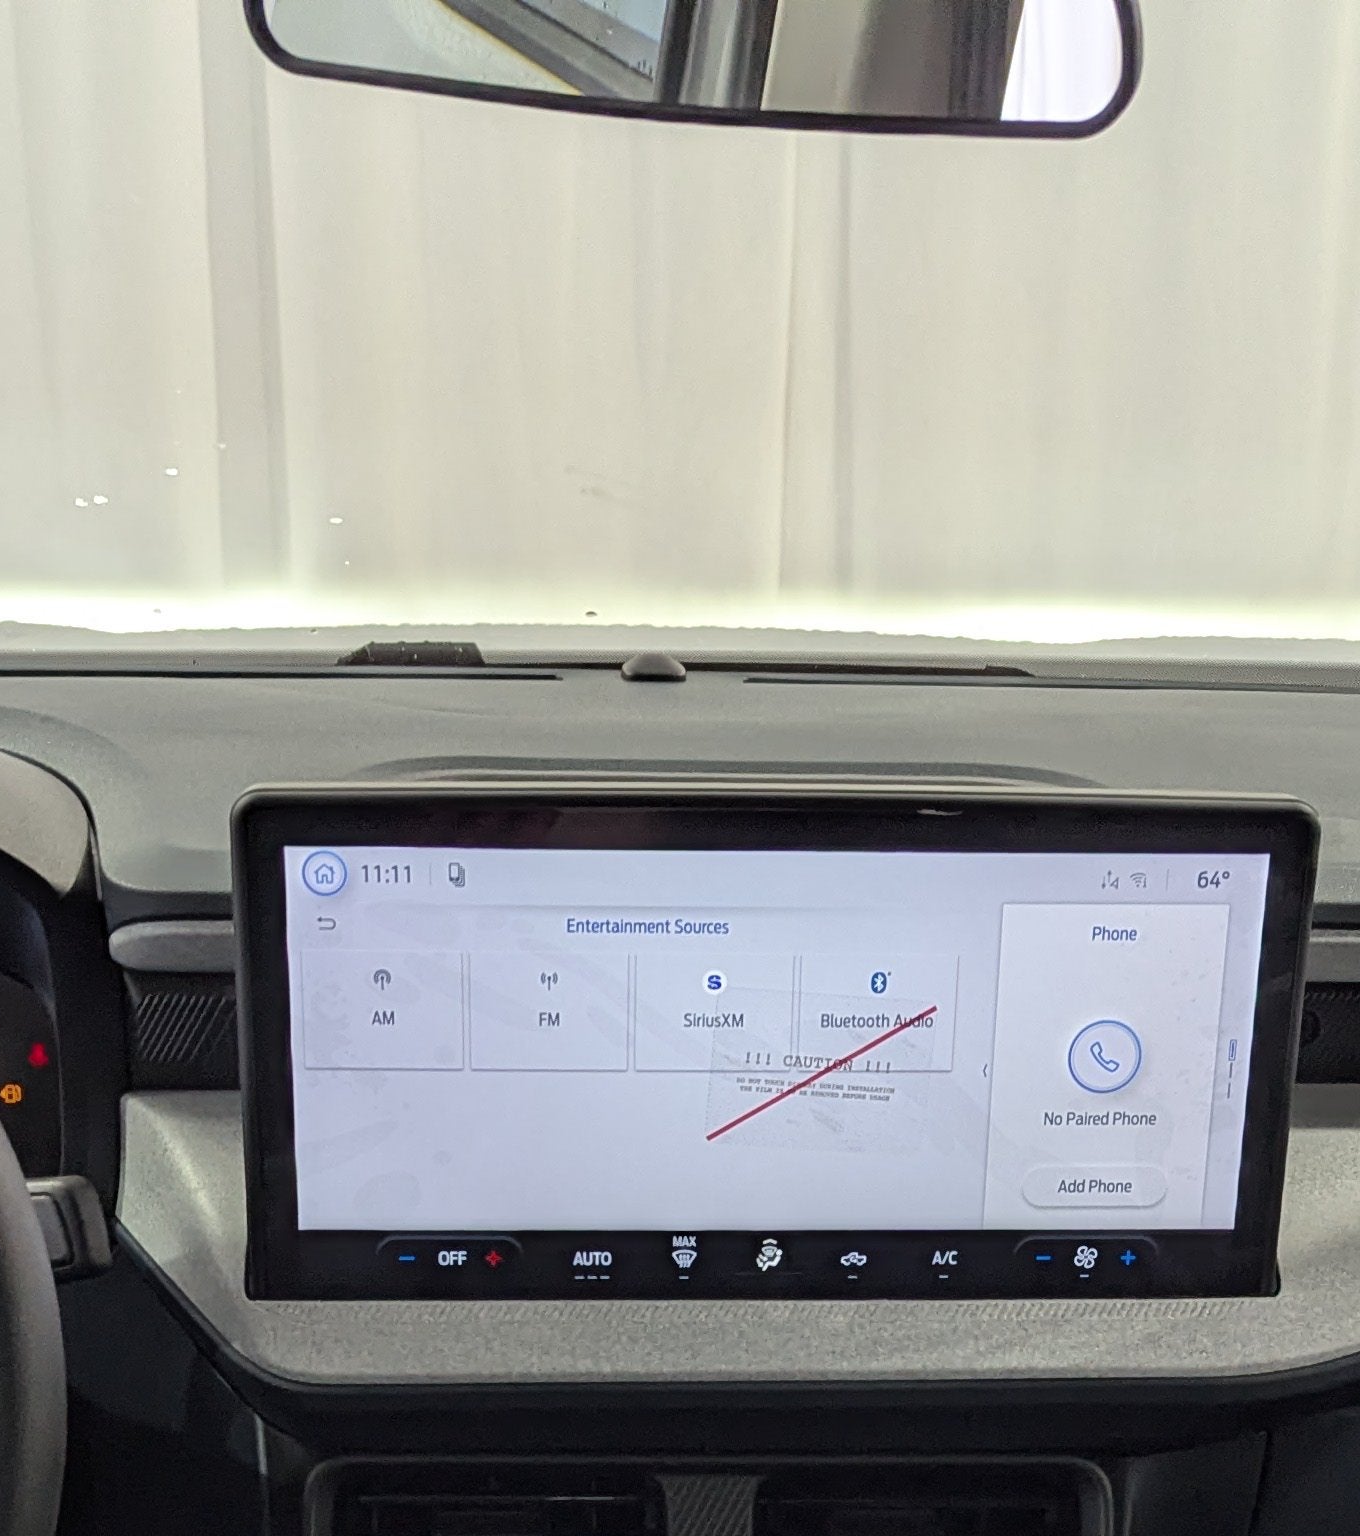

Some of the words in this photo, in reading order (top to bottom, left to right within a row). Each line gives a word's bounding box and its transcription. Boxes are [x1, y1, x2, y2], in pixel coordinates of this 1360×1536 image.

[361, 865, 412, 884] 11:11
[1197, 871, 1230, 889] 64°
[566, 918, 671, 934] Entertainment
[674, 918, 729, 934] Sources
[1092, 925, 1138, 942] Phone
[372, 1011, 395, 1026] AM
[539, 1012, 560, 1027] FM
[683, 1012, 744, 1028] SiriusXM
[820, 1013, 890, 1028] Bluetooth
[893, 1013, 934, 1028] Audio
[783, 1055, 853, 1072] CAUTION
[1043, 1111, 1061, 1126] No
[1065, 1110, 1109, 1126] Paired
[1112, 1110, 1157, 1127] Phone
[1057, 1179, 1086, 1194] Add
[1089, 1179, 1132, 1196] Phone
[672, 1235, 697, 1248] MAX
[438, 1251, 467, 1266] OFF
[573, 1251, 612, 1266] AUTO
[932, 1250, 958, 1266] A/C
